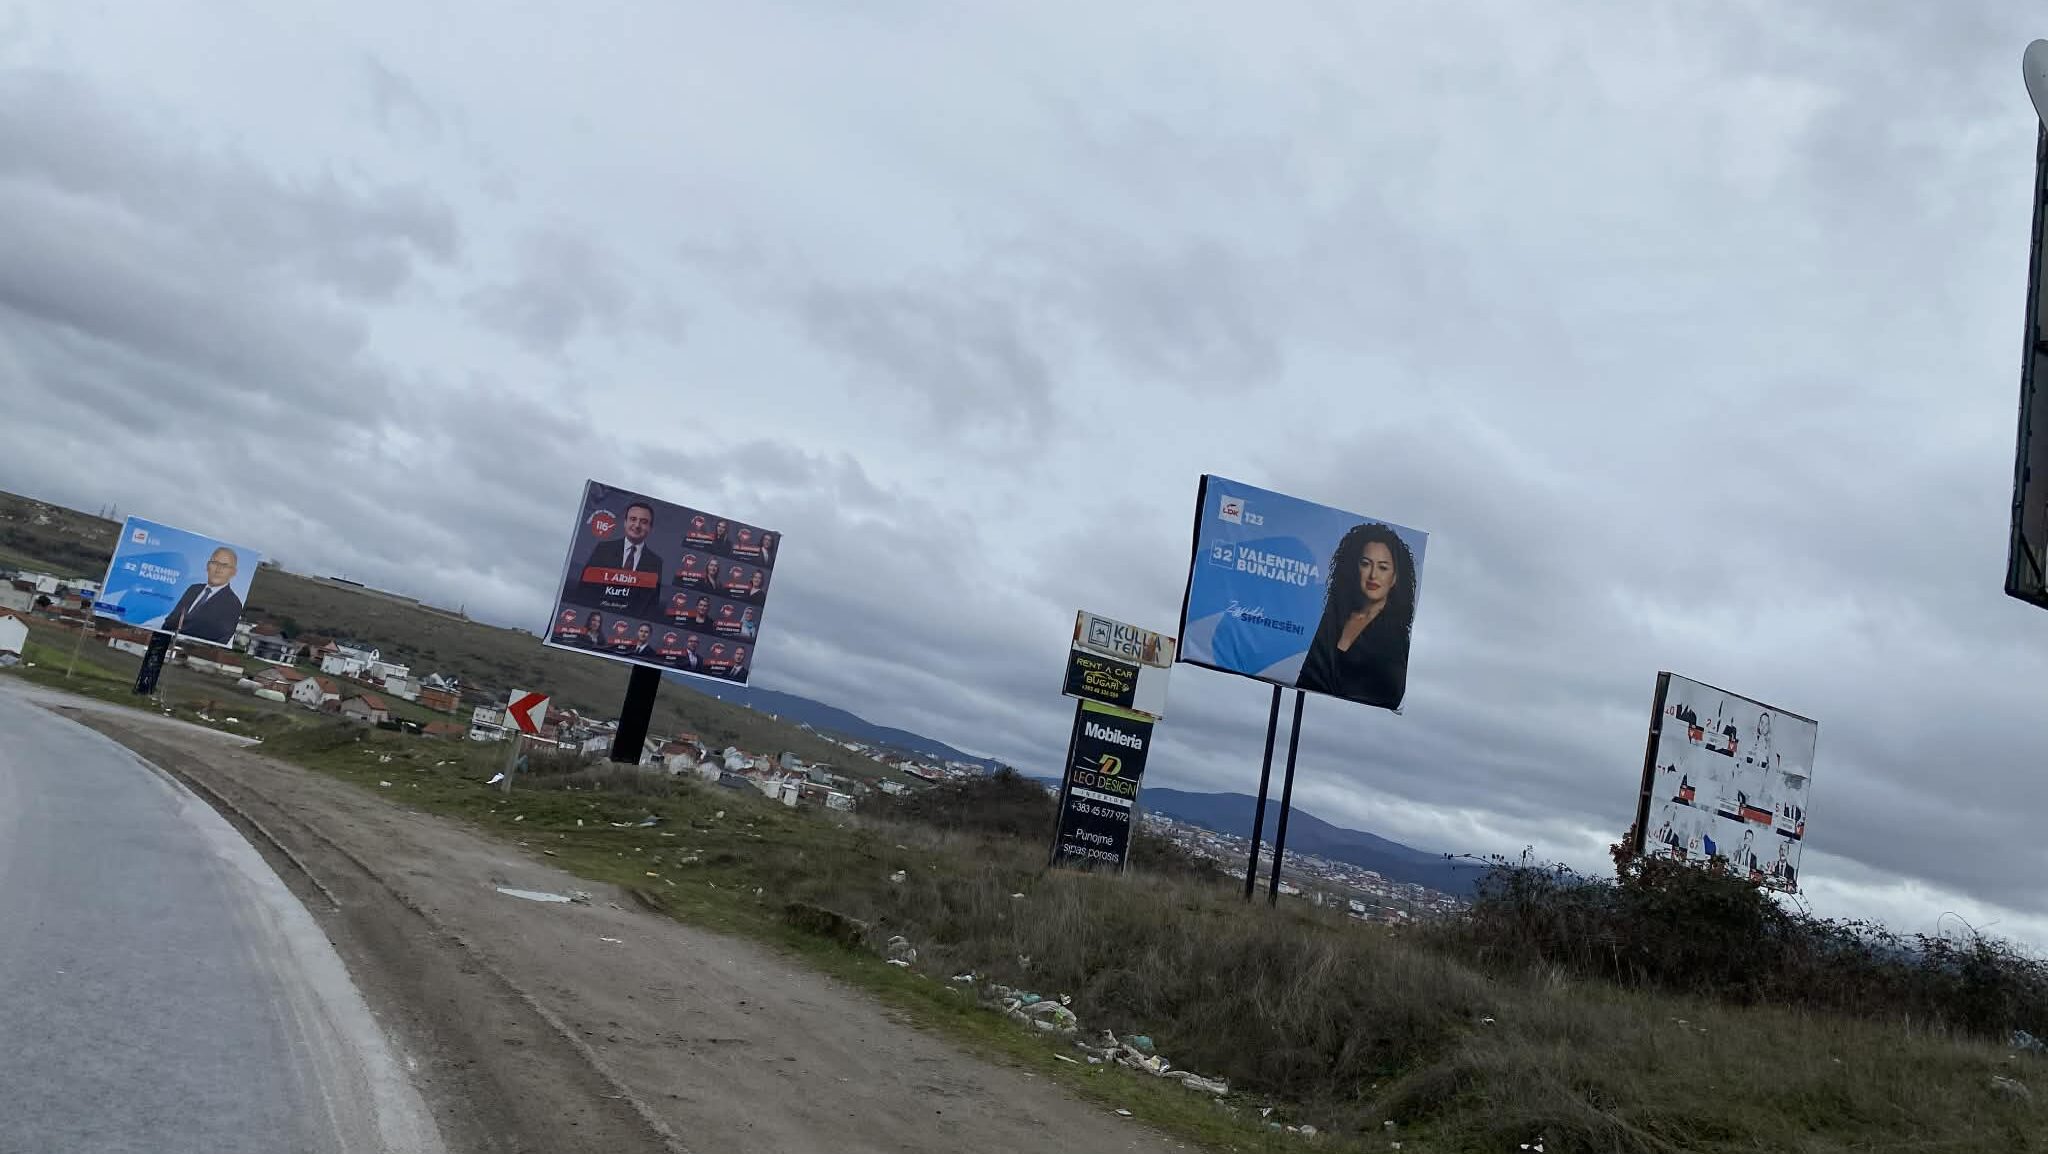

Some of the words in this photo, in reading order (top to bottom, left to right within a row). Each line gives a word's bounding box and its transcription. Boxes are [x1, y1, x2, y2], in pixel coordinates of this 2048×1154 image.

[596, 520, 609, 532] 116
[1213, 547, 1233, 562] 32
[1239, 546, 1320, 578] VALENTINA
[611, 574, 637, 584] Albin
[1236, 559, 1308, 587] BUNJAKU
[605, 586, 629, 597] Kurti
[1076, 658, 1103, 670] RENT
[1105, 666, 1112, 674] A
[1114, 669, 1133, 679] CAR
[1084, 721, 1143, 750] Mobileria
[1073, 769, 1095, 786] LEO
[1097, 775, 1137, 796] DESIGN
[1072, 800, 1090, 814] +383
[1091, 806, 1101, 816] 45
[1101, 807, 1114, 819] 577
[1115, 811, 1129, 822] 972
